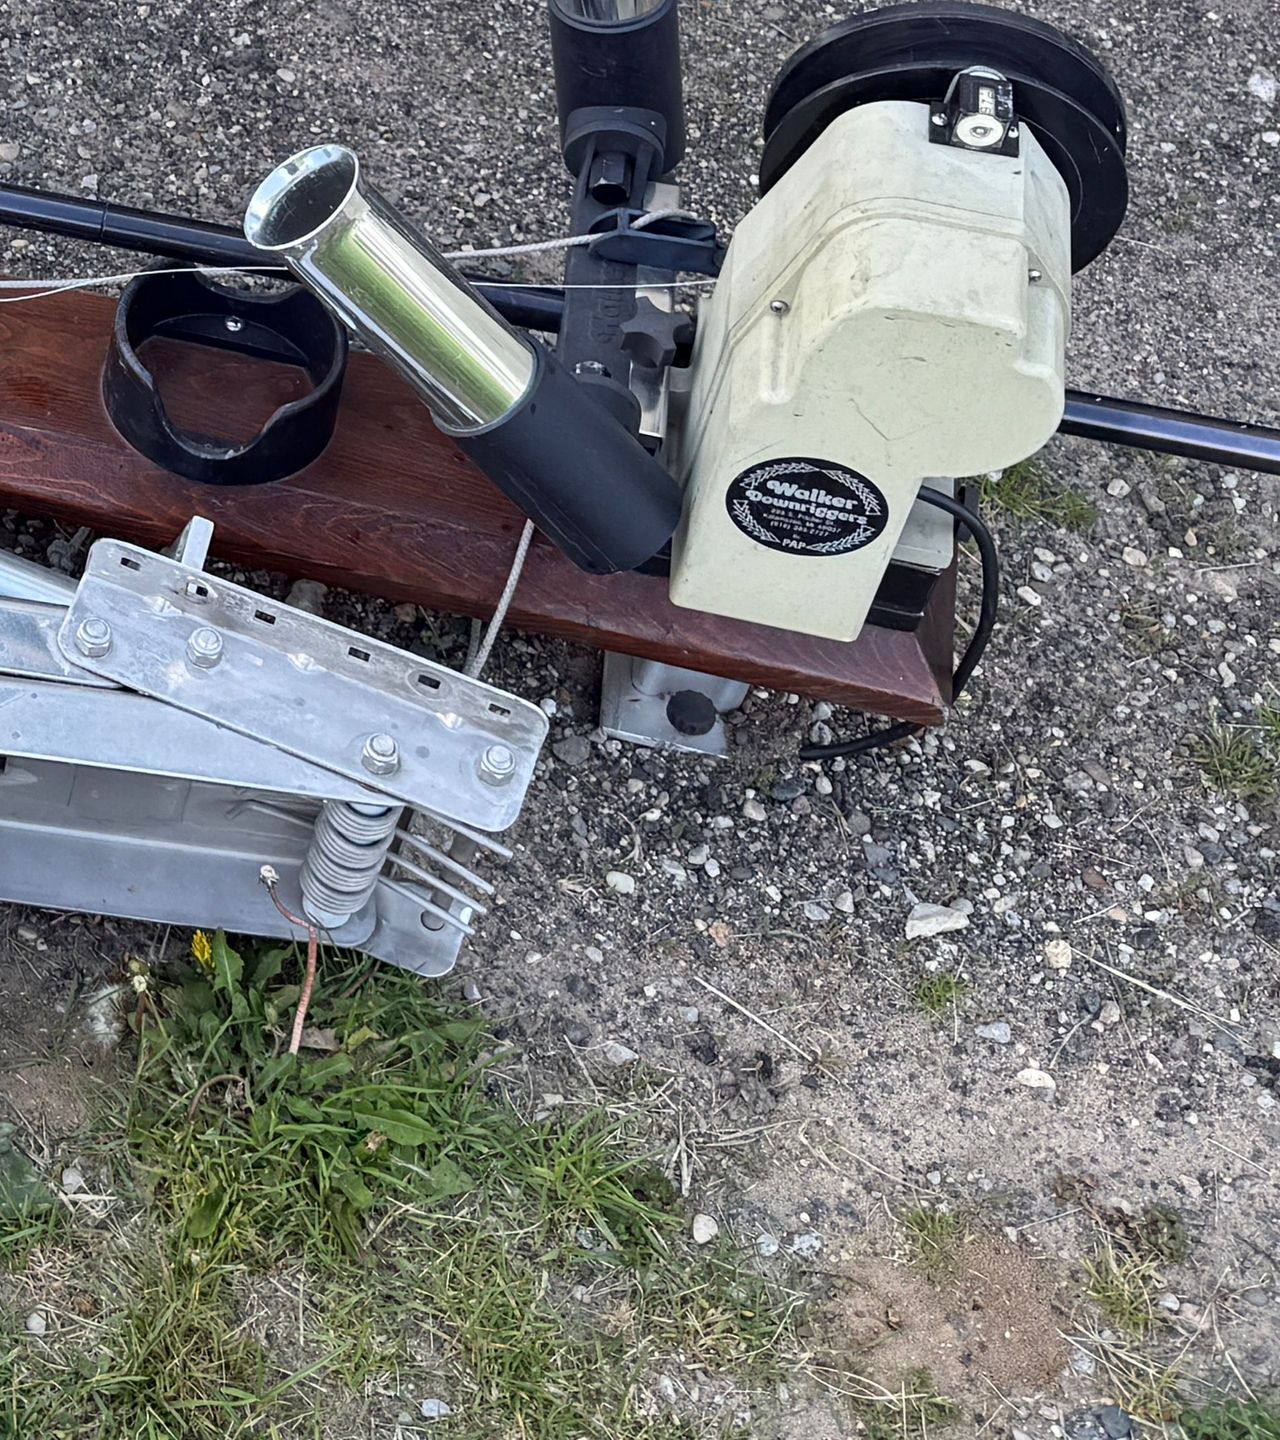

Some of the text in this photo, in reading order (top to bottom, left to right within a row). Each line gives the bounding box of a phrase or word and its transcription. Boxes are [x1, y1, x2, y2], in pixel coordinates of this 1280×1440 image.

[745, 489, 868, 525] Downriggers
[766, 479, 858, 510] Walker
[782, 538, 806, 549] PAP
